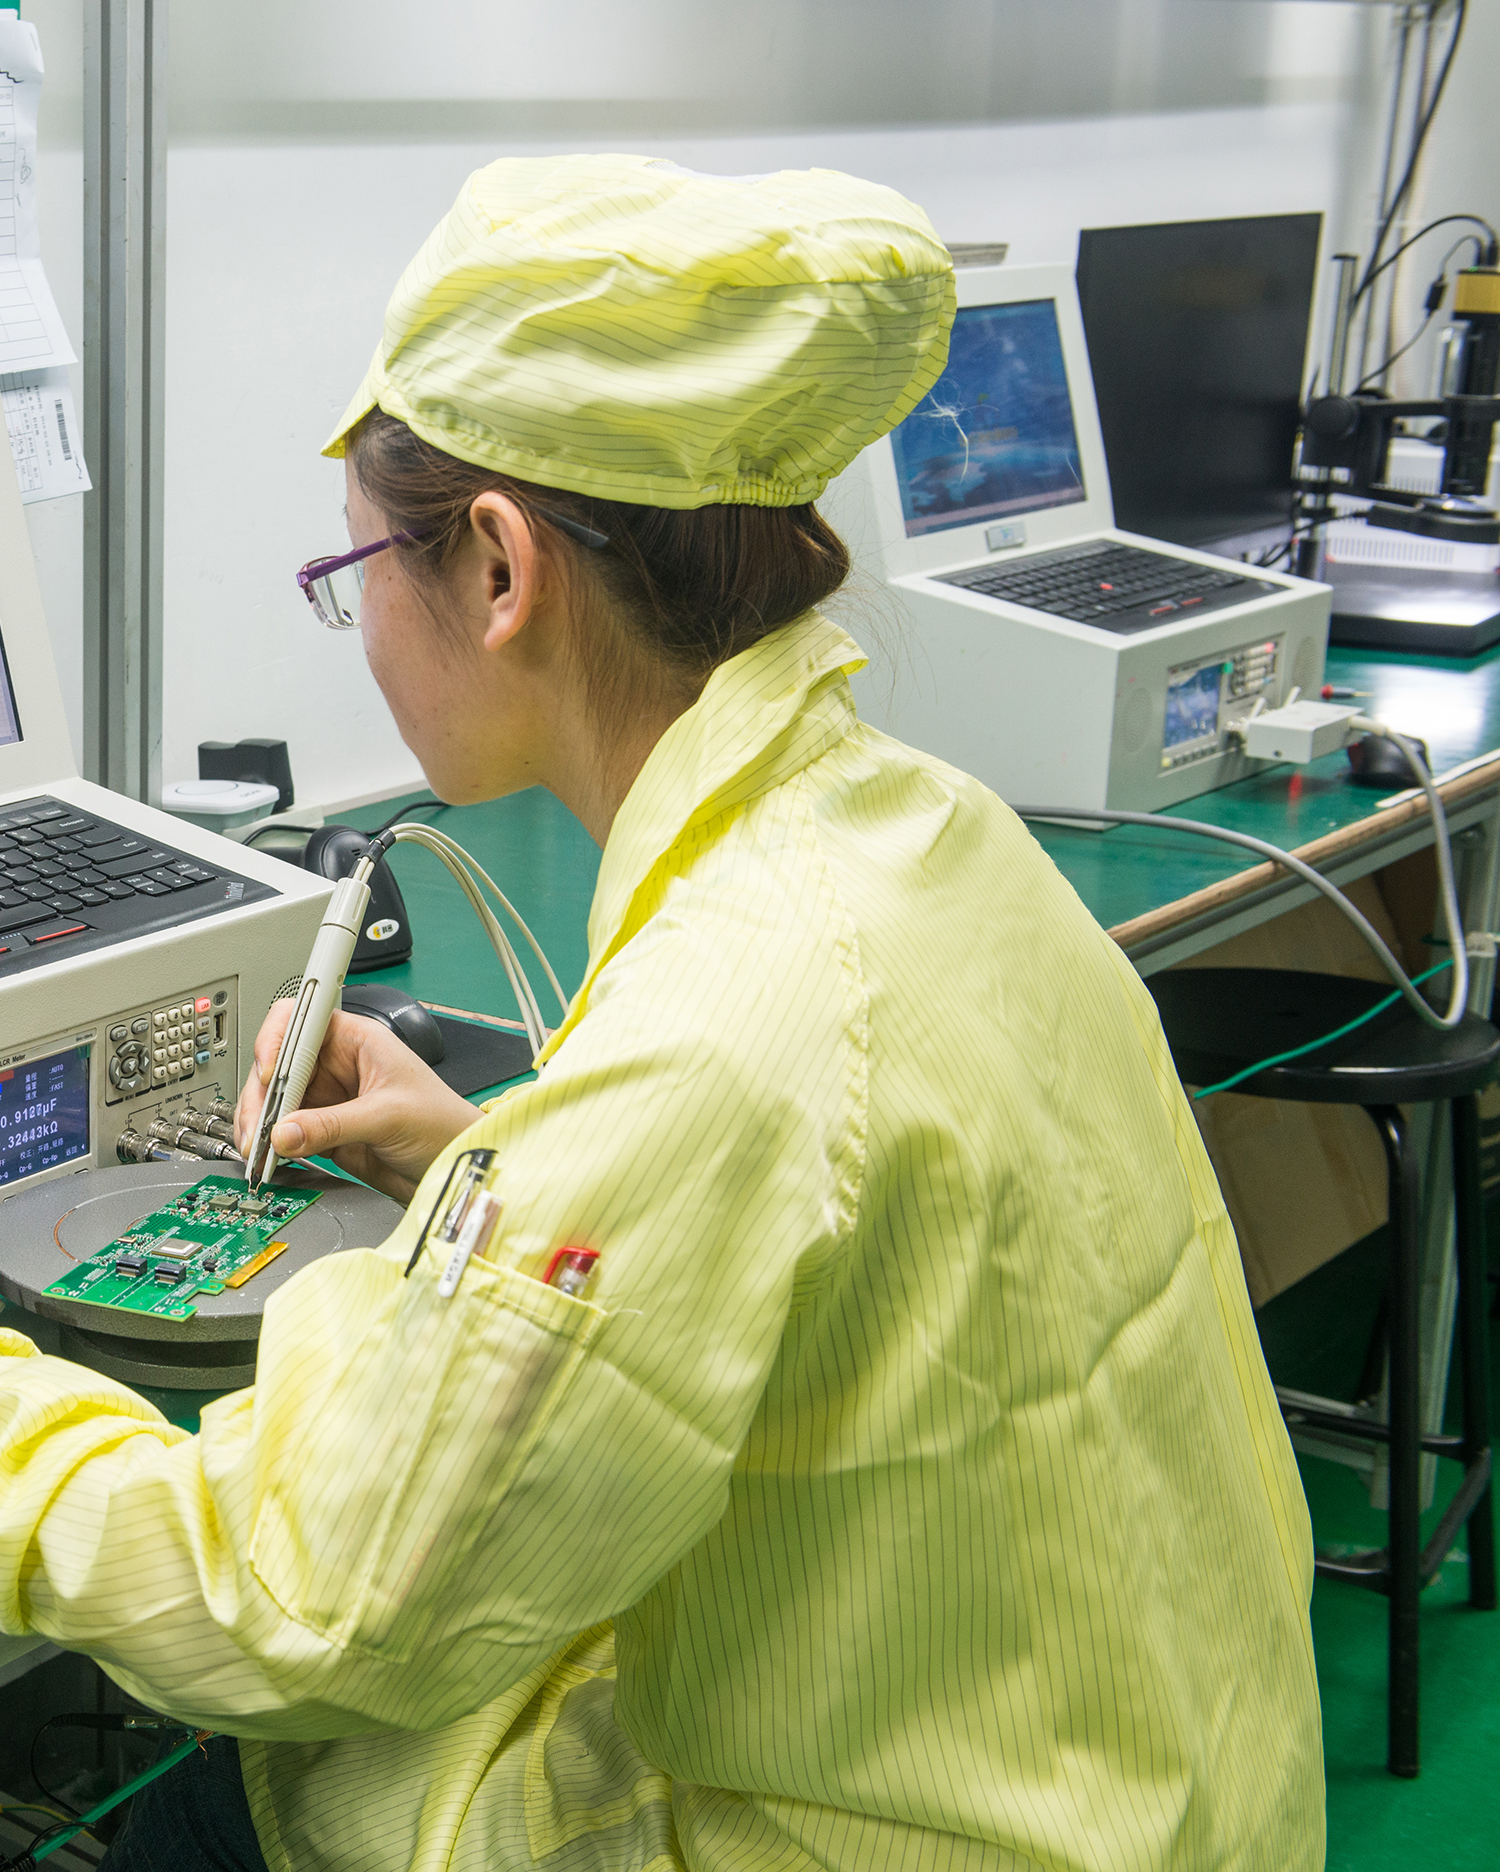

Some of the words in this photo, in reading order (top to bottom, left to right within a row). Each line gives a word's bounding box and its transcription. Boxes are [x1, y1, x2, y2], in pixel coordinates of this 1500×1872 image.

[388, 1003, 418, 1020] lenovo
[0, 1058, 11, 1068] LCR
[12, 1053, 26, 1063] Meter
[25, 1072, 37, 1083] 量程
[165, 1093, 183, 1104] UNKNOWN
[65, 1145, 77, 1156] 返回
